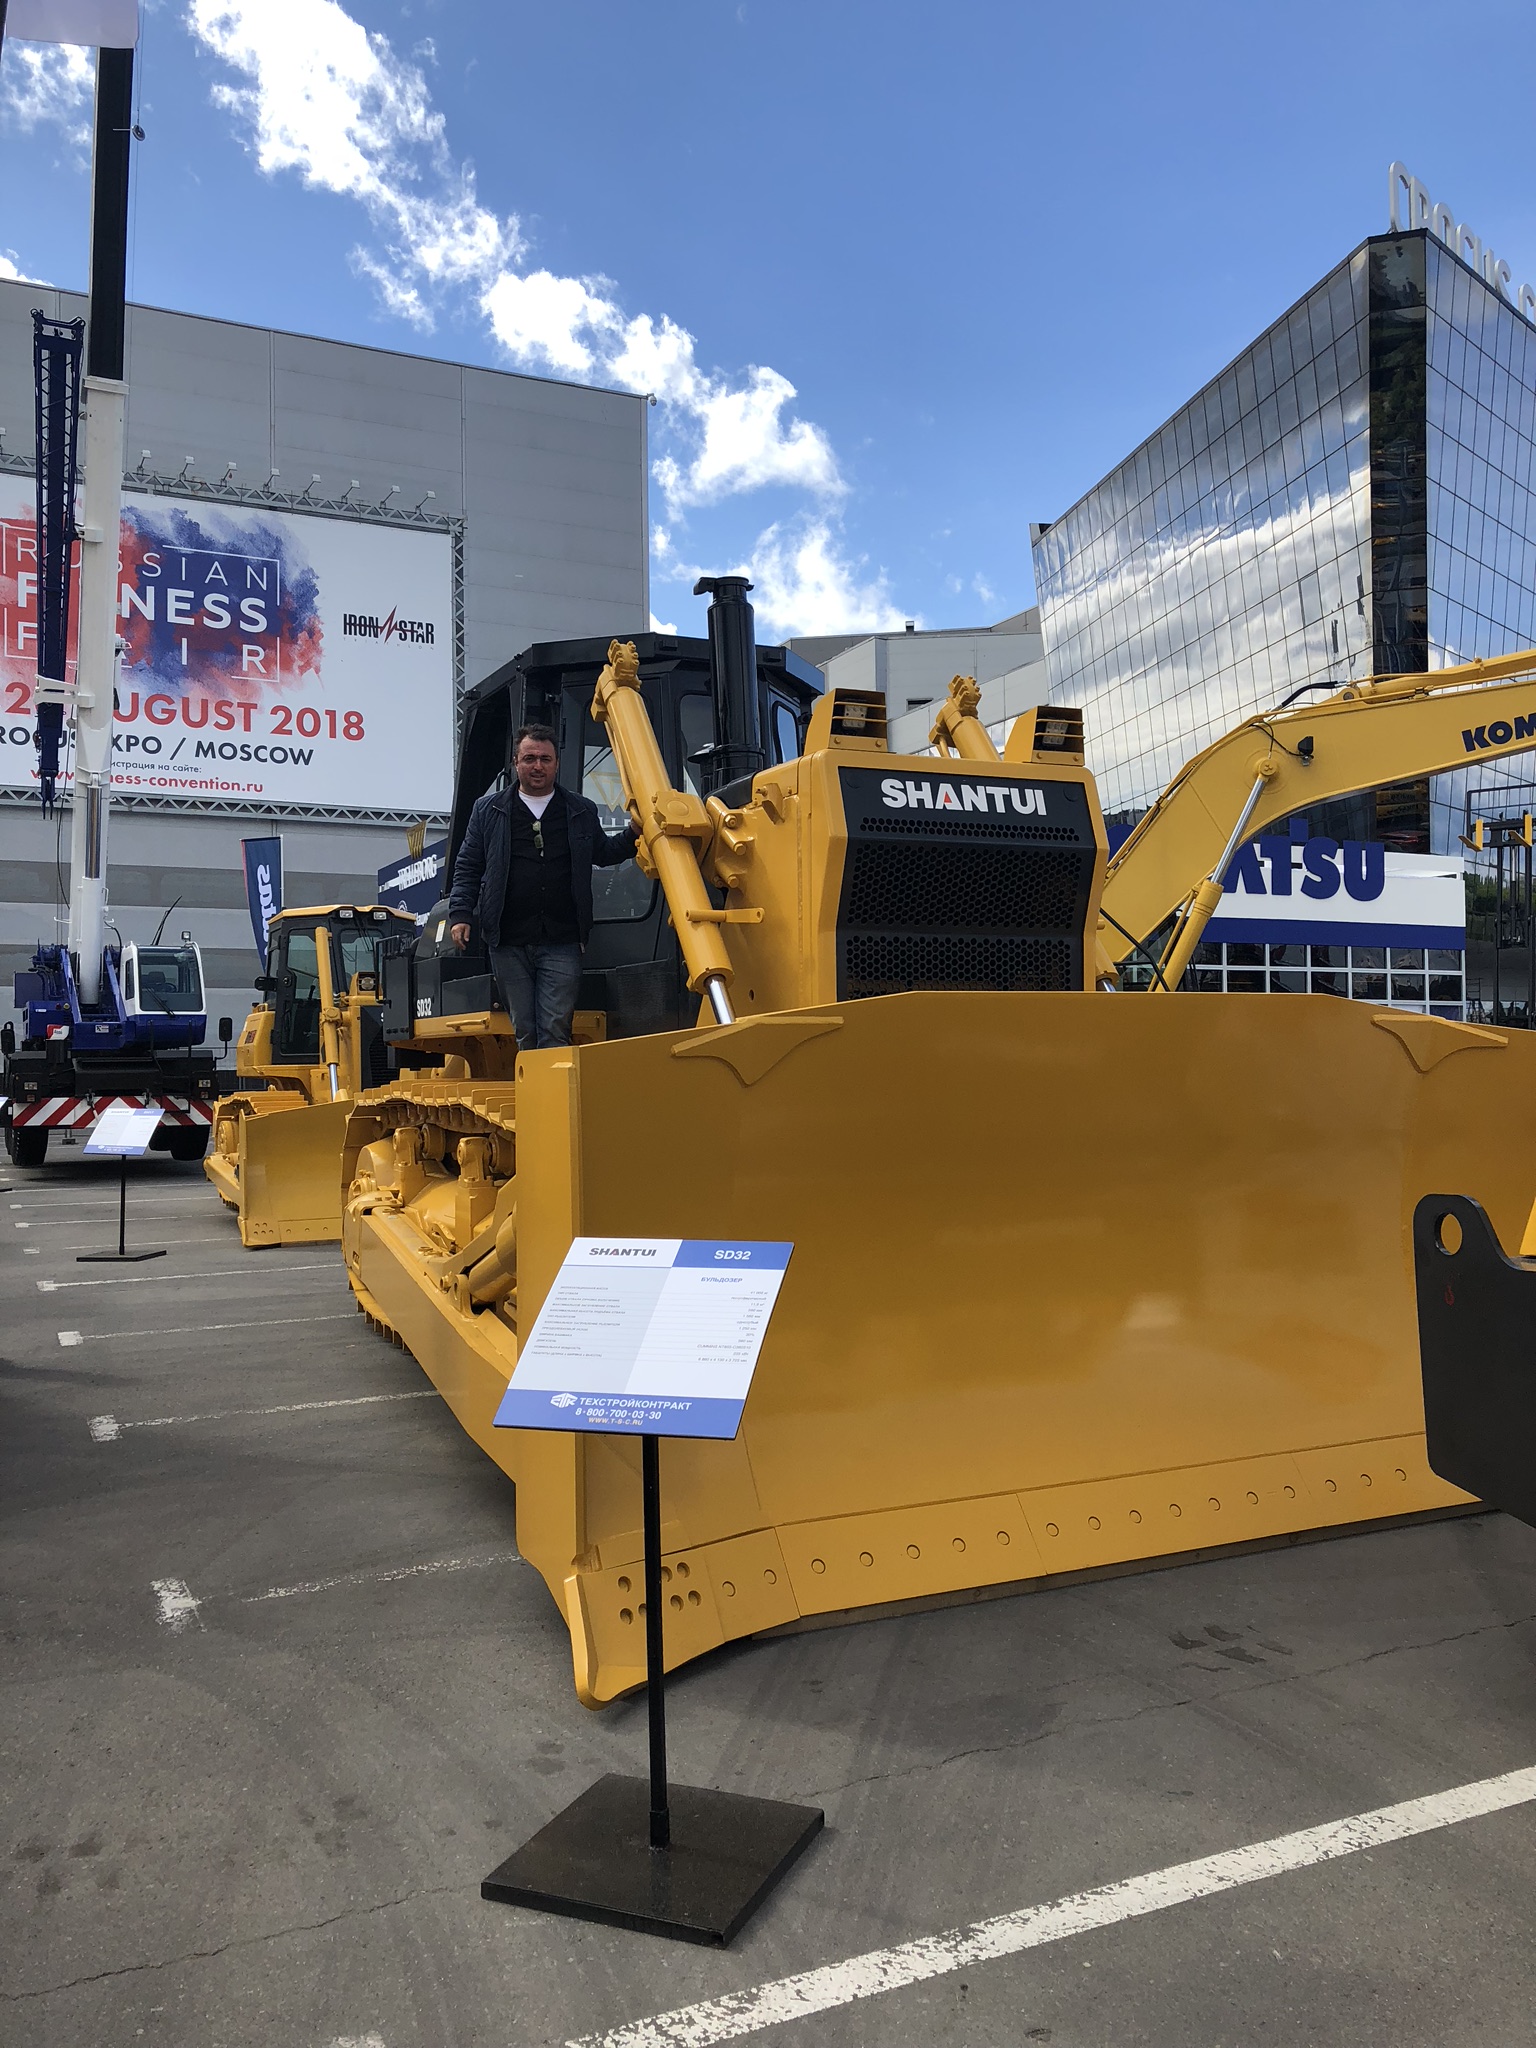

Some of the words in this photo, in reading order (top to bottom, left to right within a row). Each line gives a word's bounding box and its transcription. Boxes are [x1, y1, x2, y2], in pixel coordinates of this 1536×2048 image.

[18, 571, 268, 633] FNESS
[343, 613, 379, 639] IRON
[398, 620, 435, 645] STAR
[18, 621, 267, 674] FIR
[112, 692, 258, 733] UGUST
[269, 705, 366, 742] 2018
[1461, 712, 1536, 753] KOM
[112, 734, 162, 755] XPO
[195, 740, 314, 766] MOSCOW
[881, 778, 1048, 816] SHANTUI
[416, 998, 432, 1018] SD32
[588, 1247, 657, 1257] SHANTUI
[713, 1249, 752, 1261] SD32
[701, 1276, 743, 1284] БУЛЬДОЗЕР
[579, 1397, 692, 1411] ТЕХСТРОЙКОНТРАКТ
